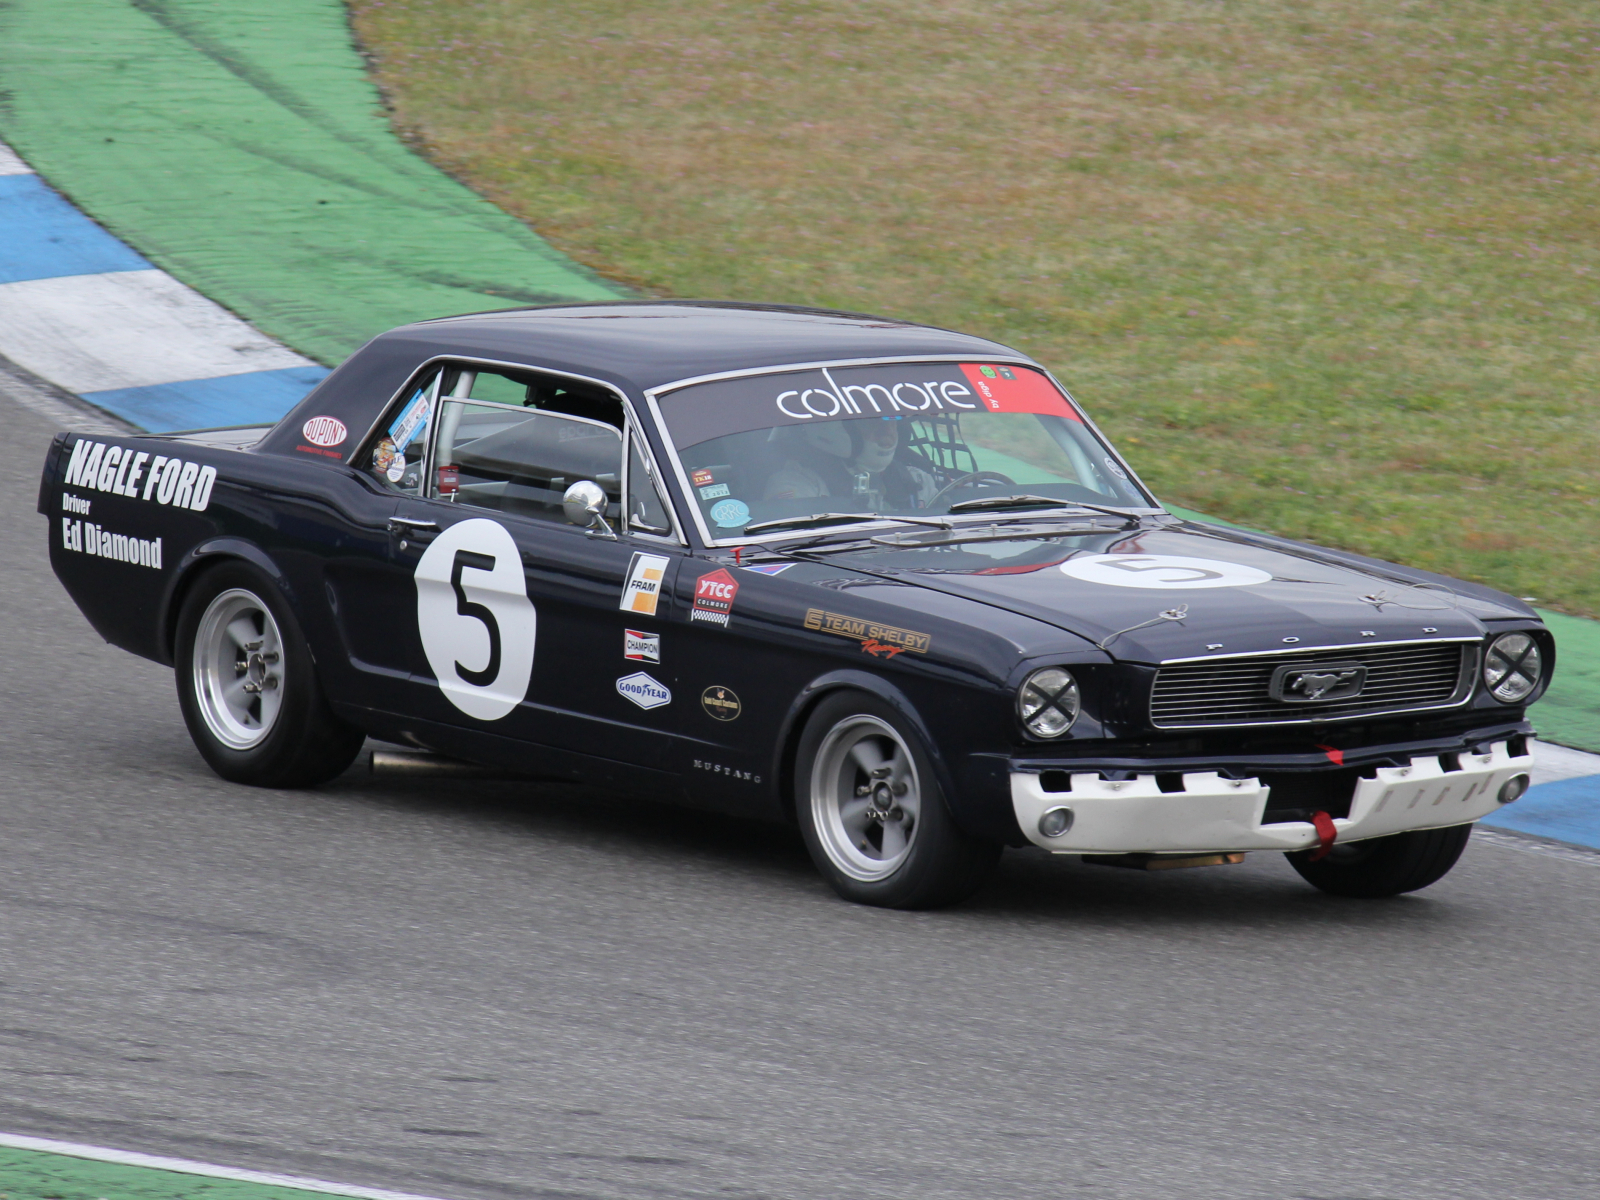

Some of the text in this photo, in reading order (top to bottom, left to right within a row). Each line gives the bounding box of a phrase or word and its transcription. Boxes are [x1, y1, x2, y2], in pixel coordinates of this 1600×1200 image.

[776, 367, 976, 419] colmore
[989, 398, 1000, 409] by
[64, 438, 217, 512] NAGLE FORD
[62, 492, 91, 516] Driver
[62, 517, 162, 569] Ed Diamond
[1095, 558, 1224, 582] 5
[630, 580, 656, 592] FRAM
[698, 579, 734, 599] YTCC
[697, 598, 728, 609] COLMORE
[450, 549, 501, 687] 5
[825, 616, 865, 635] TEAM
[868, 626, 926, 648] SHELBY
[1206, 627, 1438, 651] FORD
[626, 639, 658, 654] CHAMPION
[693, 759, 762, 784] MUSTANG
